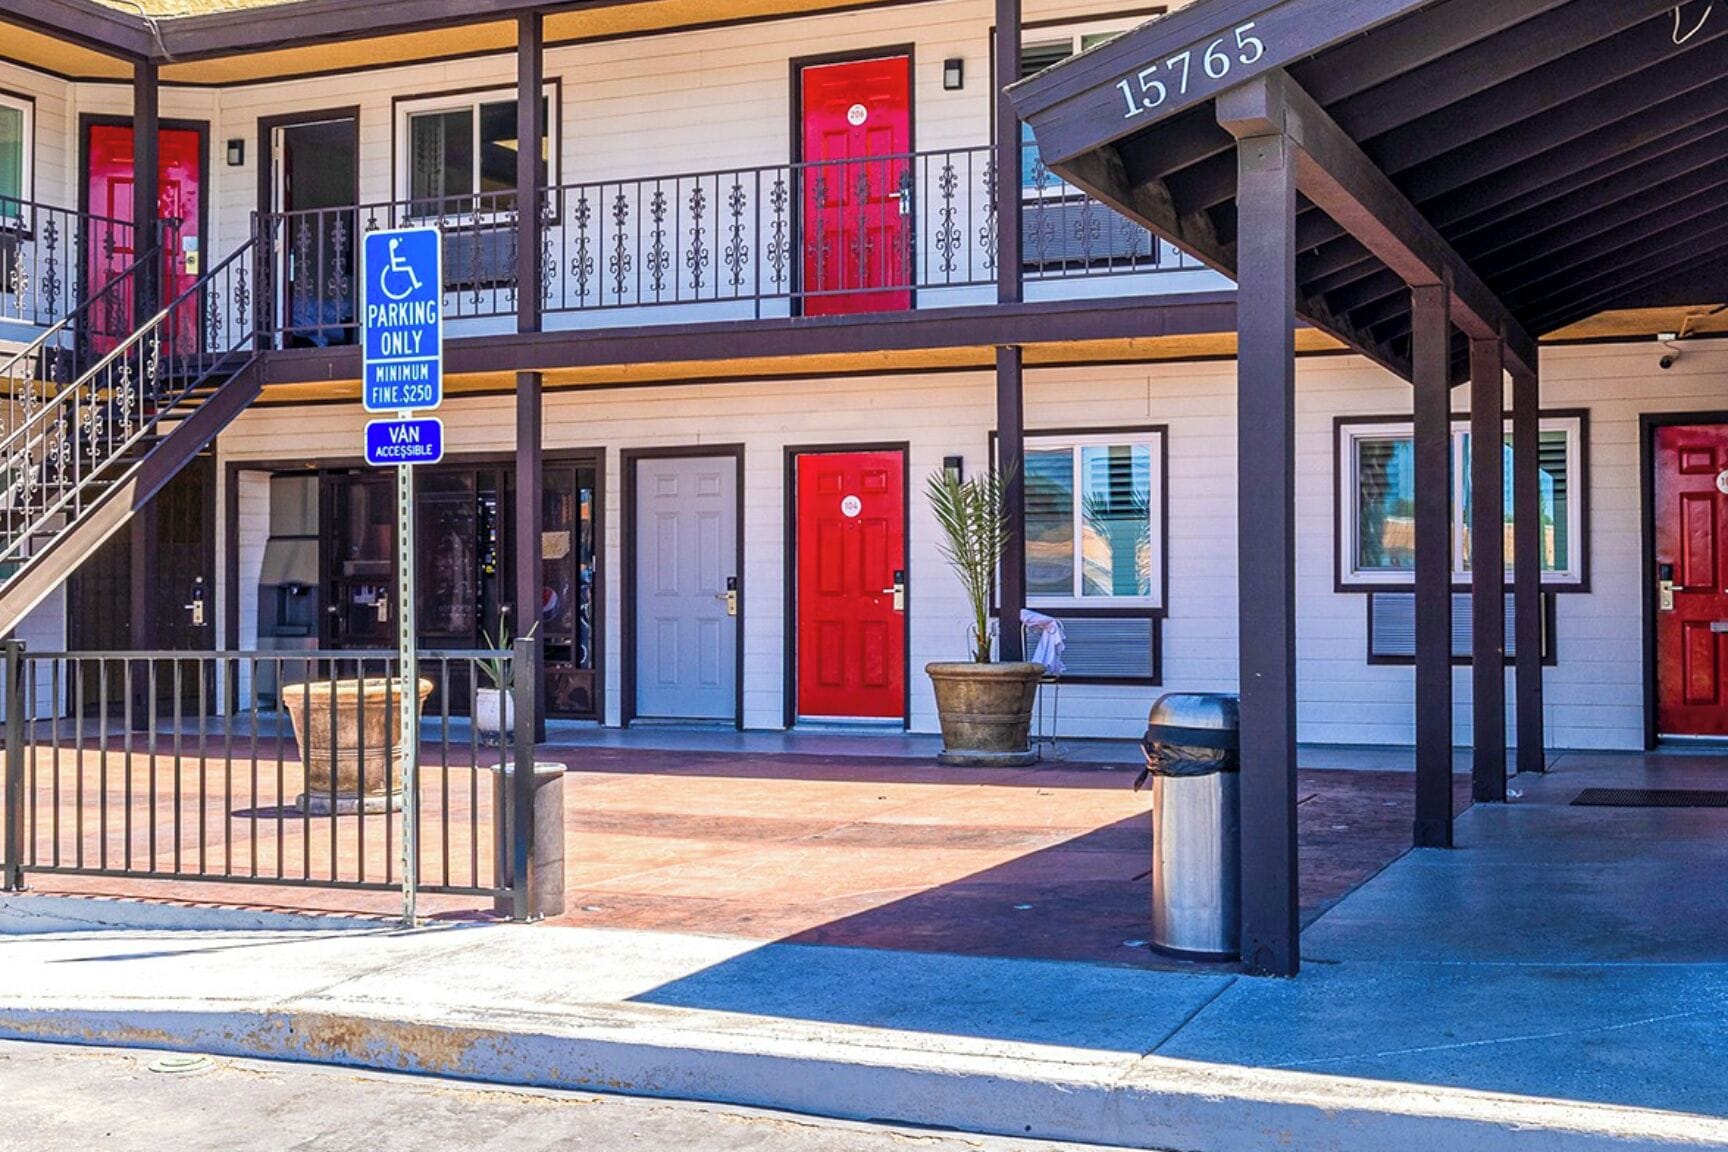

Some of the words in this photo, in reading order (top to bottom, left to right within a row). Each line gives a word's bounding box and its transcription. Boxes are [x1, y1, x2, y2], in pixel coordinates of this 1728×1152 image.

[1116, 21, 1264, 119] 15765
[368, 300, 436, 328] PARKING
[381, 330, 423, 356] ONLY
[376, 364, 428, 382] MINIMUM
[388, 424, 420, 444] VAN
[376, 444, 433, 459] ACCESSIBLE
